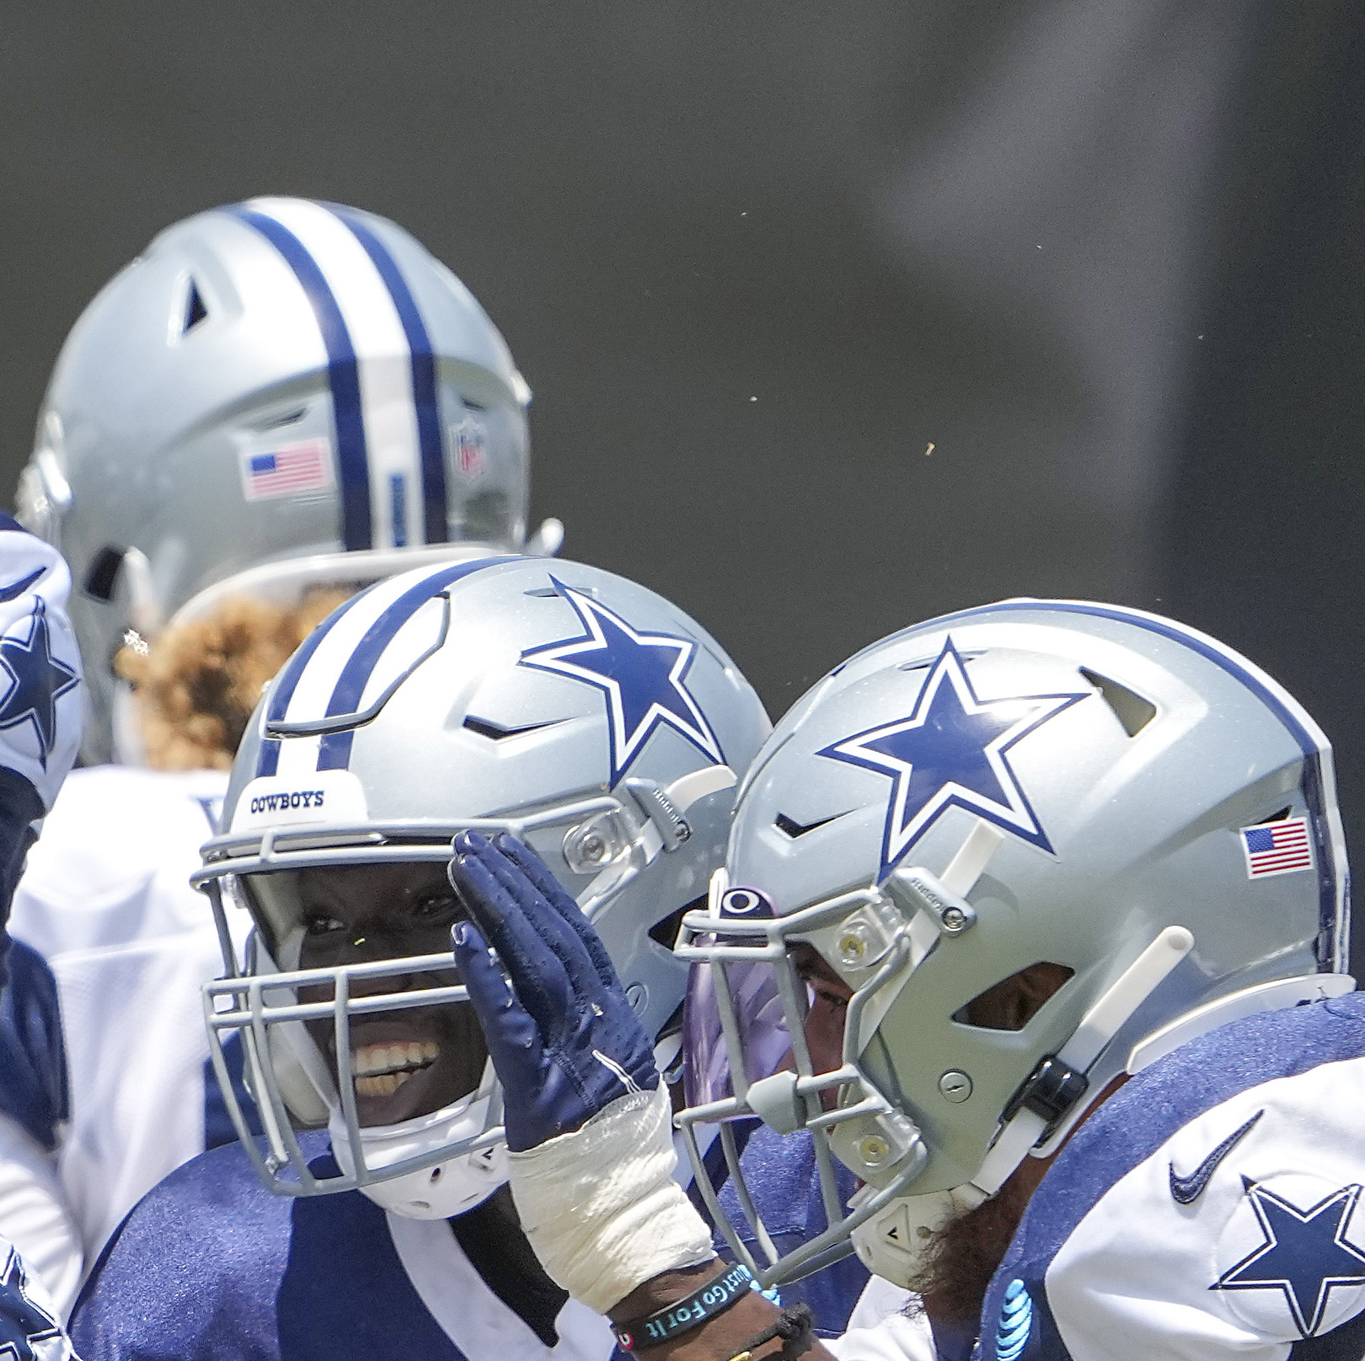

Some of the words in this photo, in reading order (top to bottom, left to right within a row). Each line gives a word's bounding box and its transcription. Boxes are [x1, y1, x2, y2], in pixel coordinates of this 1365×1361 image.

[251, 790, 325, 814] COWBOYS
[702, 1285, 728, 1304] Go
[668, 1301, 707, 1328] For
[645, 1319, 667, 1337] It
